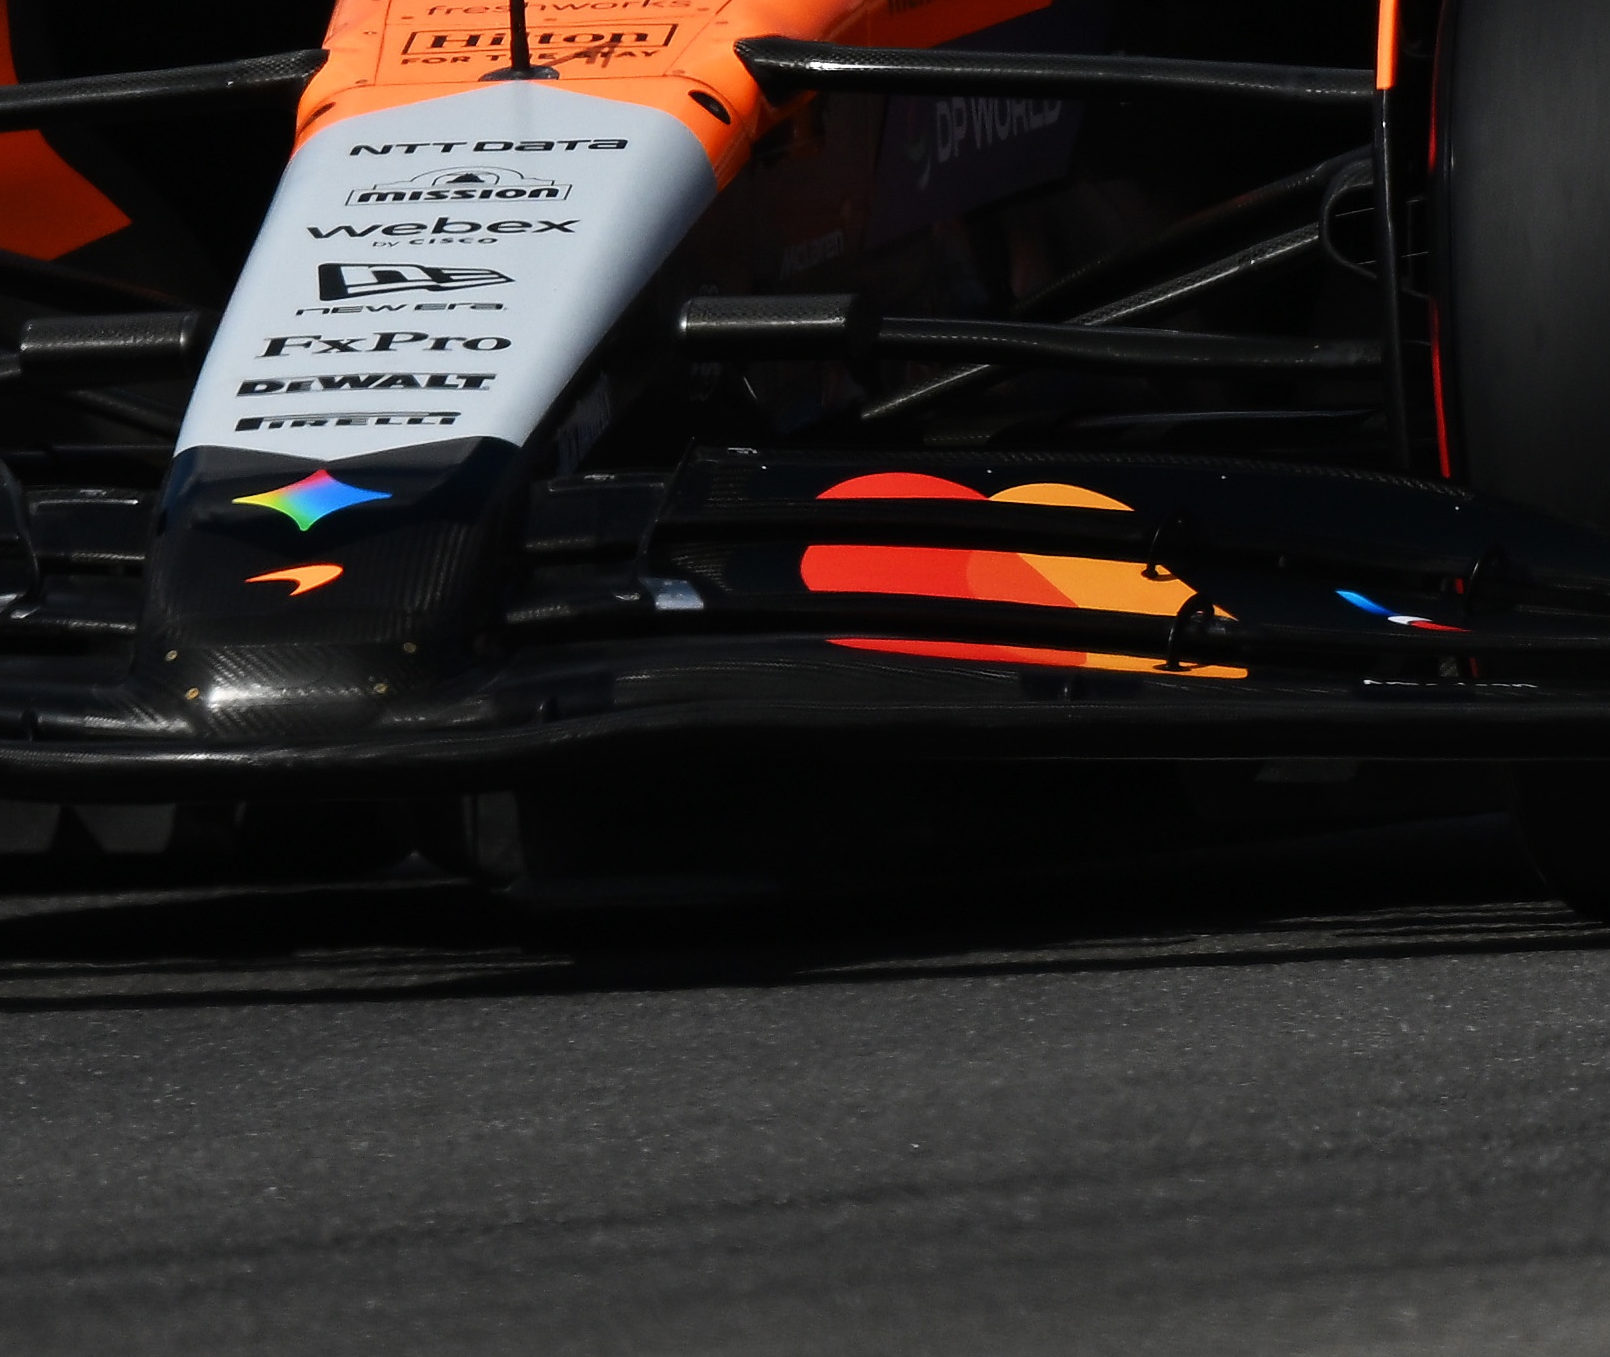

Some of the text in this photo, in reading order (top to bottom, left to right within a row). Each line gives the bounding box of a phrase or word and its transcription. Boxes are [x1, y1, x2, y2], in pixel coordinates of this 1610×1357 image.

[427, 32, 650, 50] Hiton
[400, 55, 472, 66] FOR
[485, 51, 559, 63] TE
[349, 142, 468, 157] NTT
[356, 187, 559, 204] mission
[306, 216, 581, 239] webex
[254, 331, 513, 359] FxPro
[235, 411, 462, 432] PIRELLI
